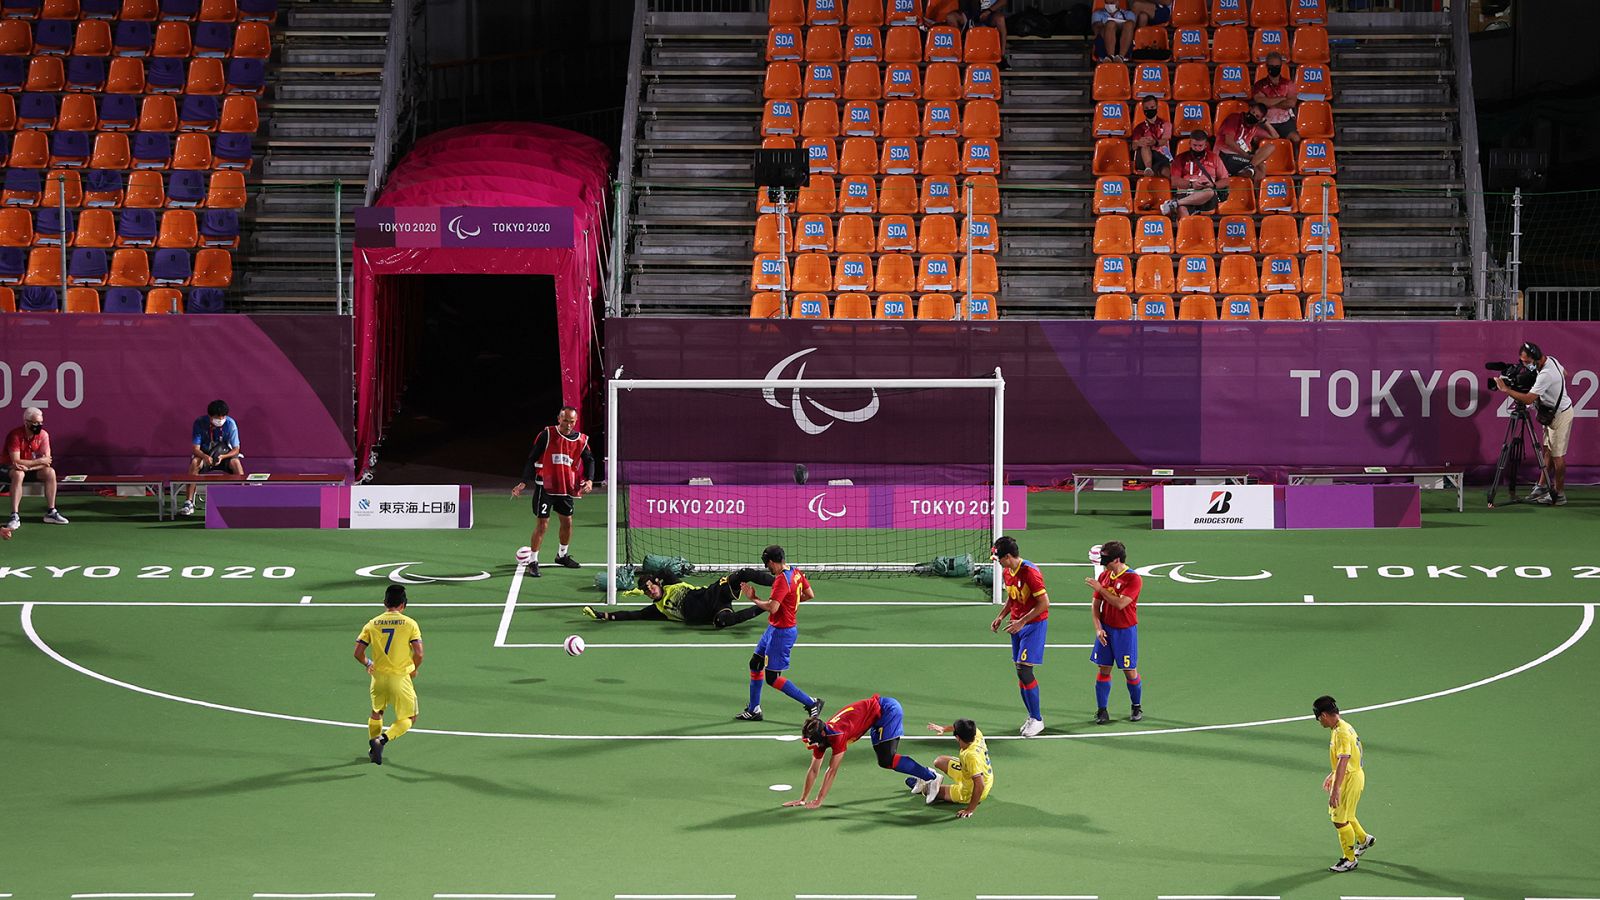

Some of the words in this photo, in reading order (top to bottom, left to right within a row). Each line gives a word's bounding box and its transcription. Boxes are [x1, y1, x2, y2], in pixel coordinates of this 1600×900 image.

[816, 0, 834, 8] SDA
[896, 0, 913, 10] SDA
[776, 36, 793, 45] SDA
[854, 36, 872, 45] SDA
[935, 36, 952, 45] SDA
[1182, 33, 1200, 42] SDA
[1262, 33, 1280, 42] SDA
[814, 69, 832, 78] SDA
[893, 72, 910, 81] SDA
[973, 72, 990, 81] SDA
[1143, 70, 1161, 79] SDA
[1223, 69, 1241, 78] SDA
[1304, 71, 1322, 80] SDA
[773, 105, 791, 114] SDA
[1103, 106, 1121, 116] SDA
[1184, 108, 1202, 117] SDA
[851, 110, 869, 120] SDA
[932, 110, 949, 119] SDA
[809, 147, 827, 157] SDA
[891, 148, 909, 158] SDA
[971, 147, 989, 157] SDA
[1307, 146, 1325, 155] SDA
[849, 185, 867, 194] SDA
[930, 185, 948, 194] SDA
[1103, 184, 1121, 193] SDA
[1268, 185, 1286, 195] SDA
[378, 222, 410, 232] TOKYO
[413, 222, 436, 232] 2020
[492, 222, 524, 232] TOKYO
[527, 222, 550, 232] 2020
[805, 224, 824, 233] SDA
[888, 226, 906, 236] SDA
[971, 224, 988, 234] SDA
[1144, 223, 1163, 233] SDA
[1227, 225, 1245, 234] SDA
[762, 262, 781, 272] SDA
[844, 264, 863, 273] SDA
[928, 263, 946, 272] SDA
[1104, 261, 1122, 270] SDA
[1187, 261, 1206, 270] SDA
[1272, 262, 1291, 272] SDA
[801, 303, 820, 313] SDA
[885, 304, 903, 313] SDA
[1146, 304, 1164, 314] SDA
[1231, 304, 1250, 313] SDA
[1315, 304, 1334, 314] SA
[1290, 370, 1478, 418] TOKYO
[379, 502, 456, 514] 東京海上日動
[541, 504, 548, 514] 2
[646, 500, 700, 514] TOKYO
[705, 500, 745, 514] 2020
[910, 500, 965, 515] TOKYO
[136, 566, 296, 578] 2020
[1332, 566, 1552, 578] TOKYO
[1570, 566, 1600, 578] 2
[382, 628, 395, 655] 7
[1021, 648, 1028, 661] 6
[1124, 655, 1130, 668] 5
